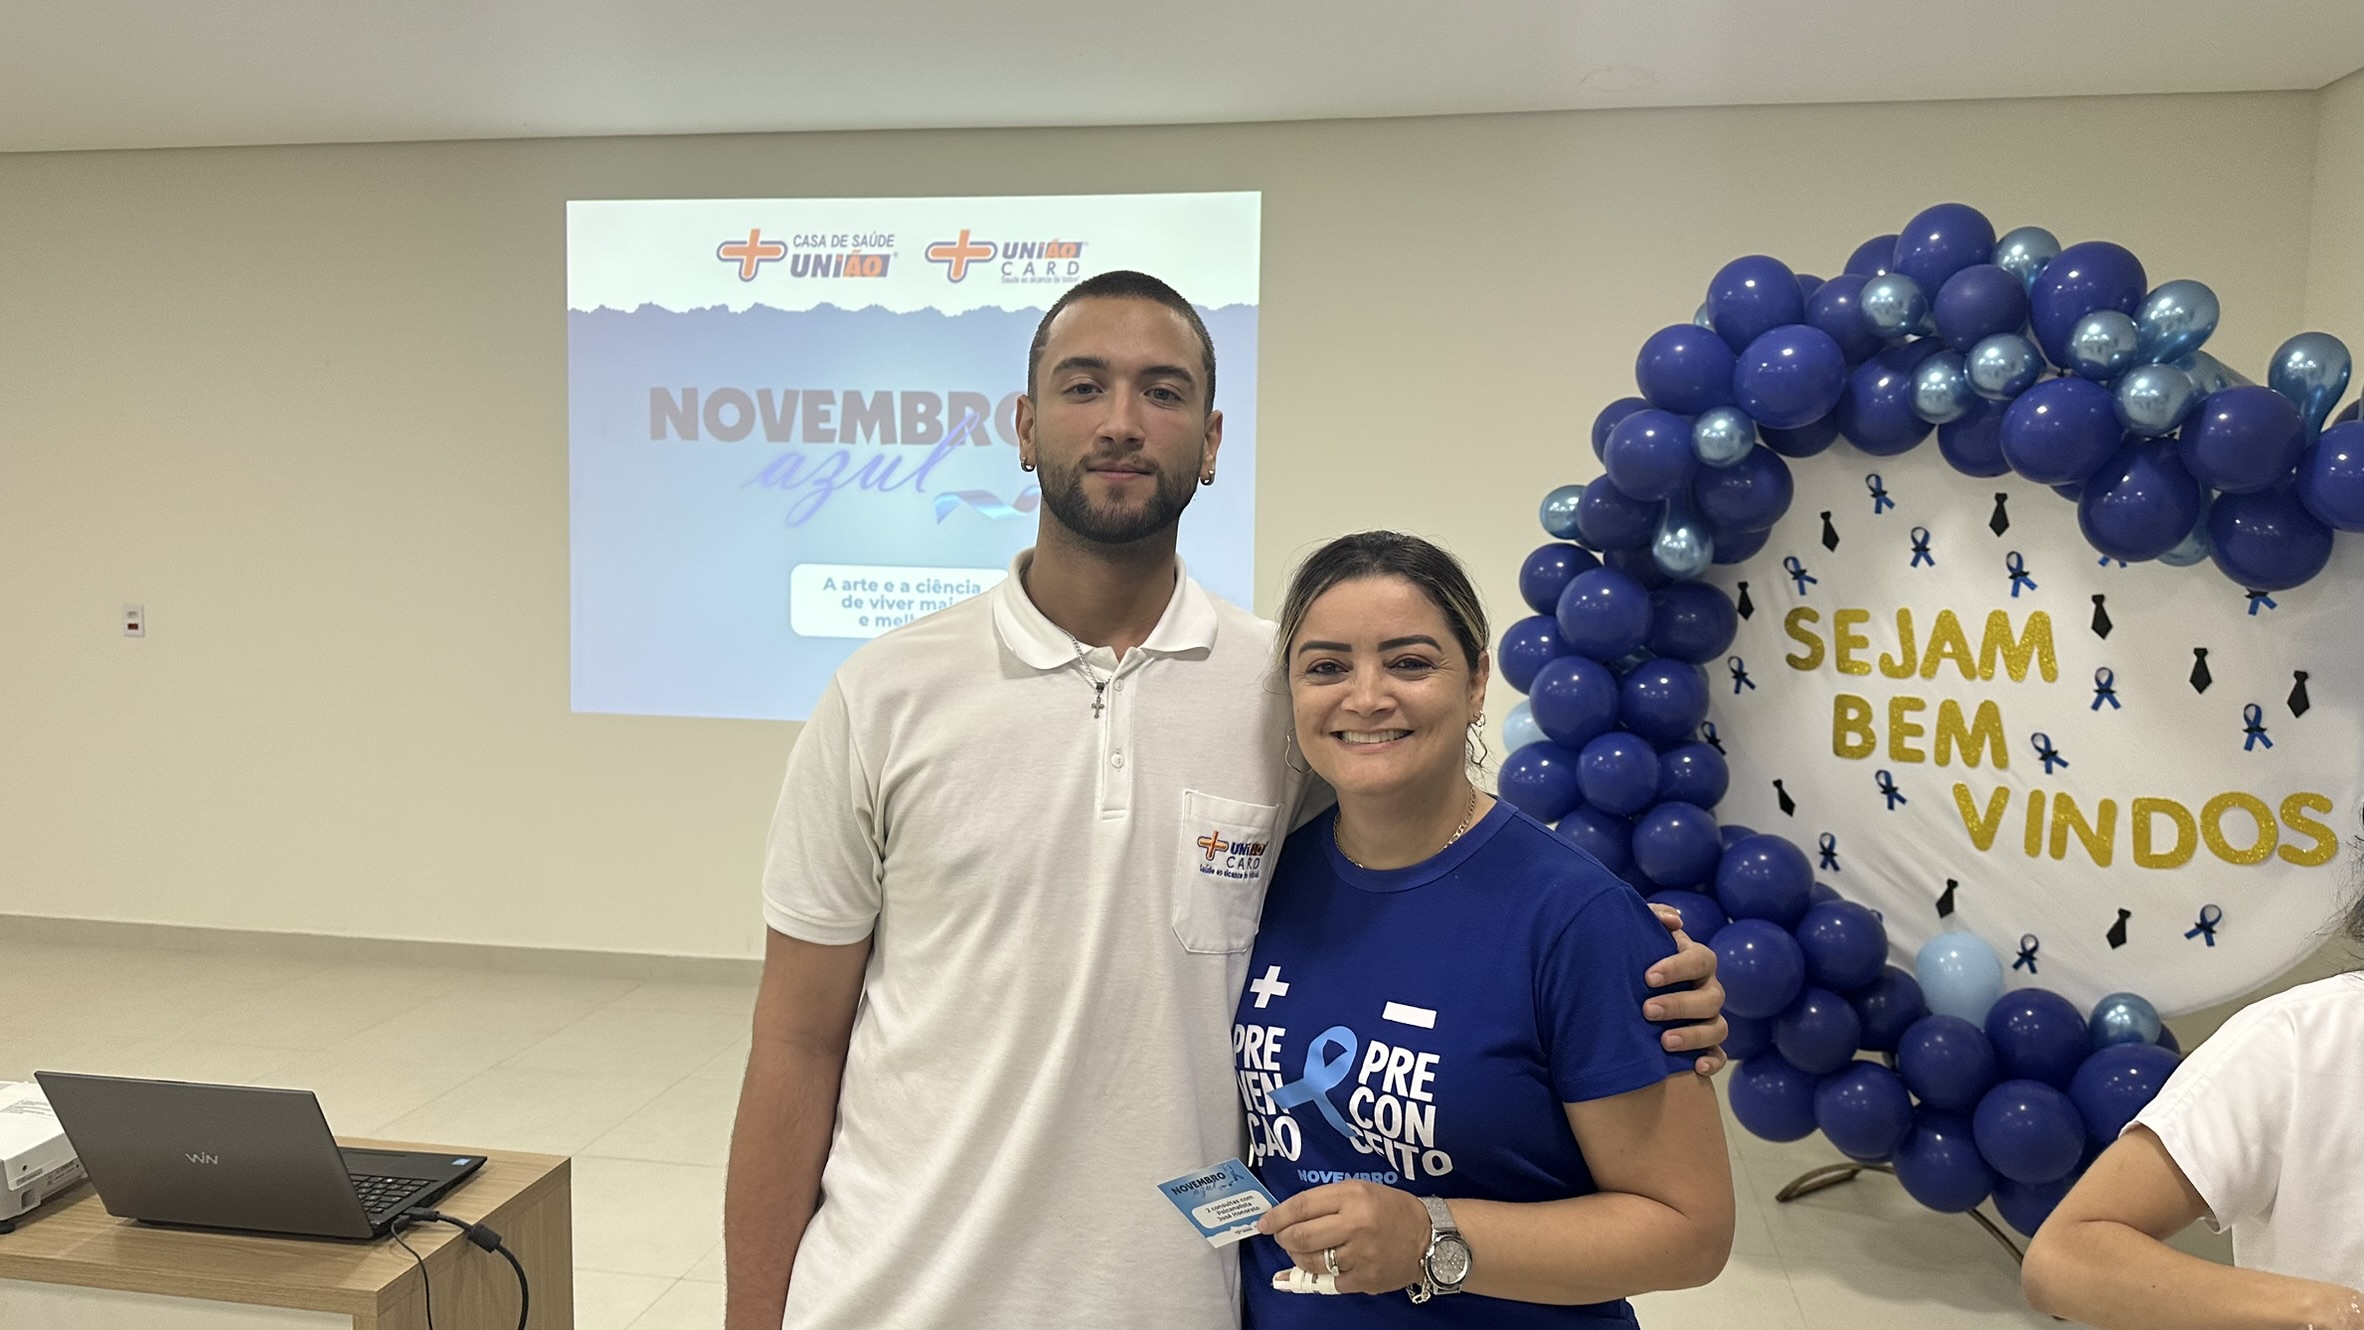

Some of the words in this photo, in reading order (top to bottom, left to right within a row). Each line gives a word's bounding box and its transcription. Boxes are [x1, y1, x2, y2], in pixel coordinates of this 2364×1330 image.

[793, 234, 826, 248] CASA
[831, 234, 848, 248] DE
[852, 231, 895, 248] SAÚDE
[1001, 261, 1080, 276] CARD
[740, 411, 980, 528] azul
[823, 577, 837, 591] A
[842, 578, 879, 593] arte
[884, 580, 895, 593] e
[900, 580, 910, 593] a
[916, 578, 982, 595] ciência
[841, 595, 864, 609] de
[869, 595, 915, 610] viver
[920, 596, 960, 610] mai
[859, 616, 869, 627] e
[1783, 606, 2058, 682] SEJAM
[1832, 693, 2010, 769] BEM
[1952, 782, 2338, 869] VINDOS
[1226, 856, 1260, 870] CARD
[1233, 1023, 1286, 1071] PRE
[1358, 1040, 1440, 1102] PRE
[1349, 1086, 1436, 1148] CON
[1171, 1172, 1226, 1196] NOVEMBRO
